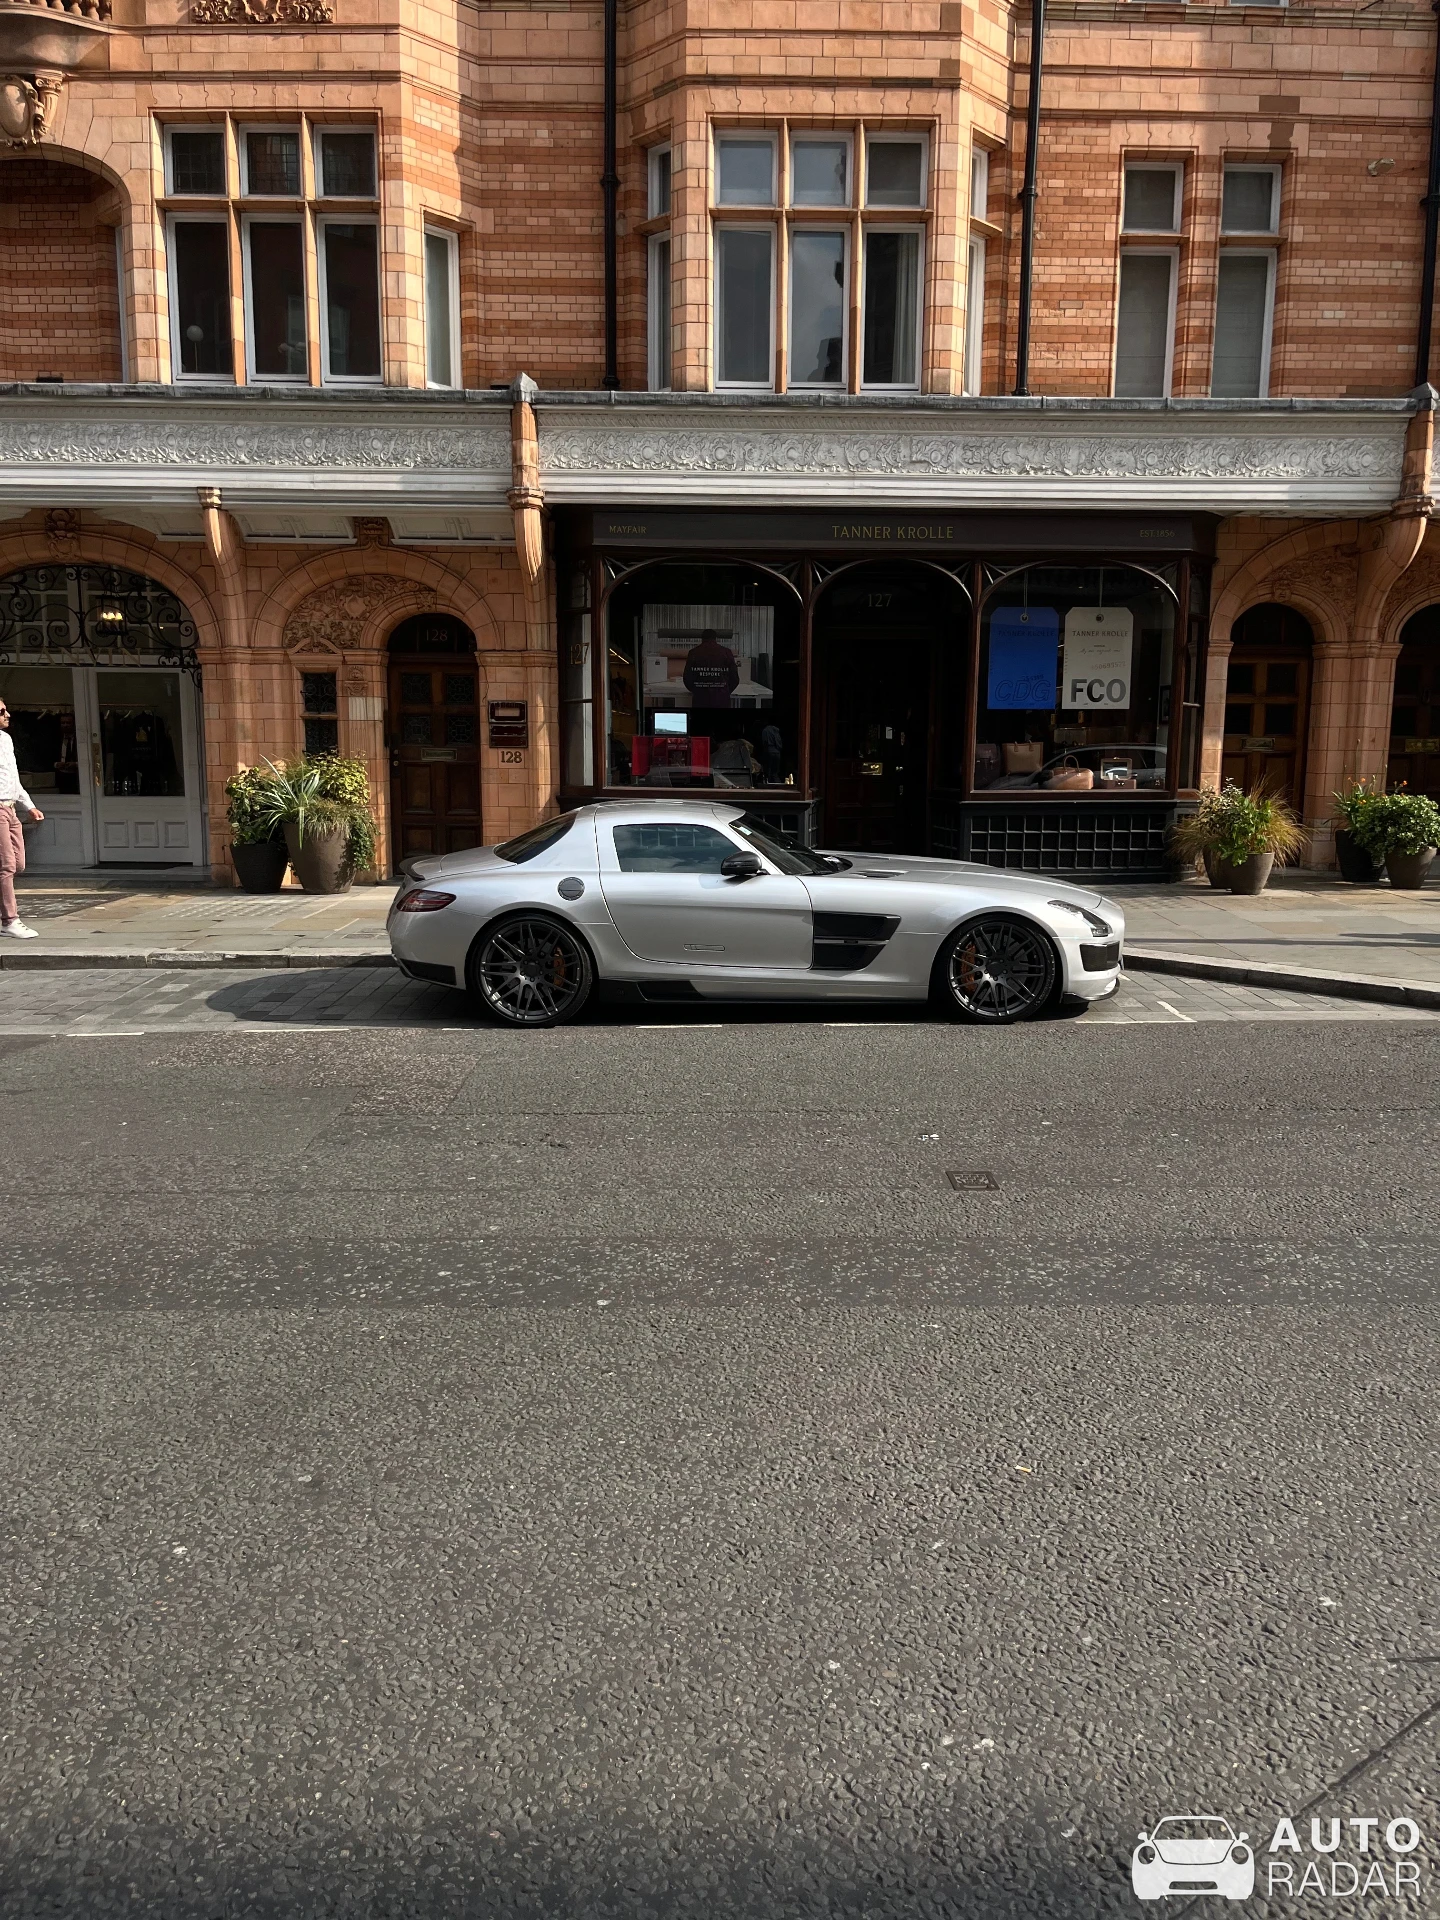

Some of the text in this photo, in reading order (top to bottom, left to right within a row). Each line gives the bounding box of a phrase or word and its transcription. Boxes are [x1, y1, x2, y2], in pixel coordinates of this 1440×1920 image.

[609, 525, 648, 534] MAYFAIR
[832, 525, 954, 539] TANNER KROLLE
[867, 593, 893, 608] 127
[426, 629, 449, 642] 128
[15, 647, 142, 667] LANVIN
[570, 642, 590, 665] 127
[994, 680, 1051, 702] CDG
[1070, 679, 1126, 703] FCO
[500, 750, 522, 764] 128
